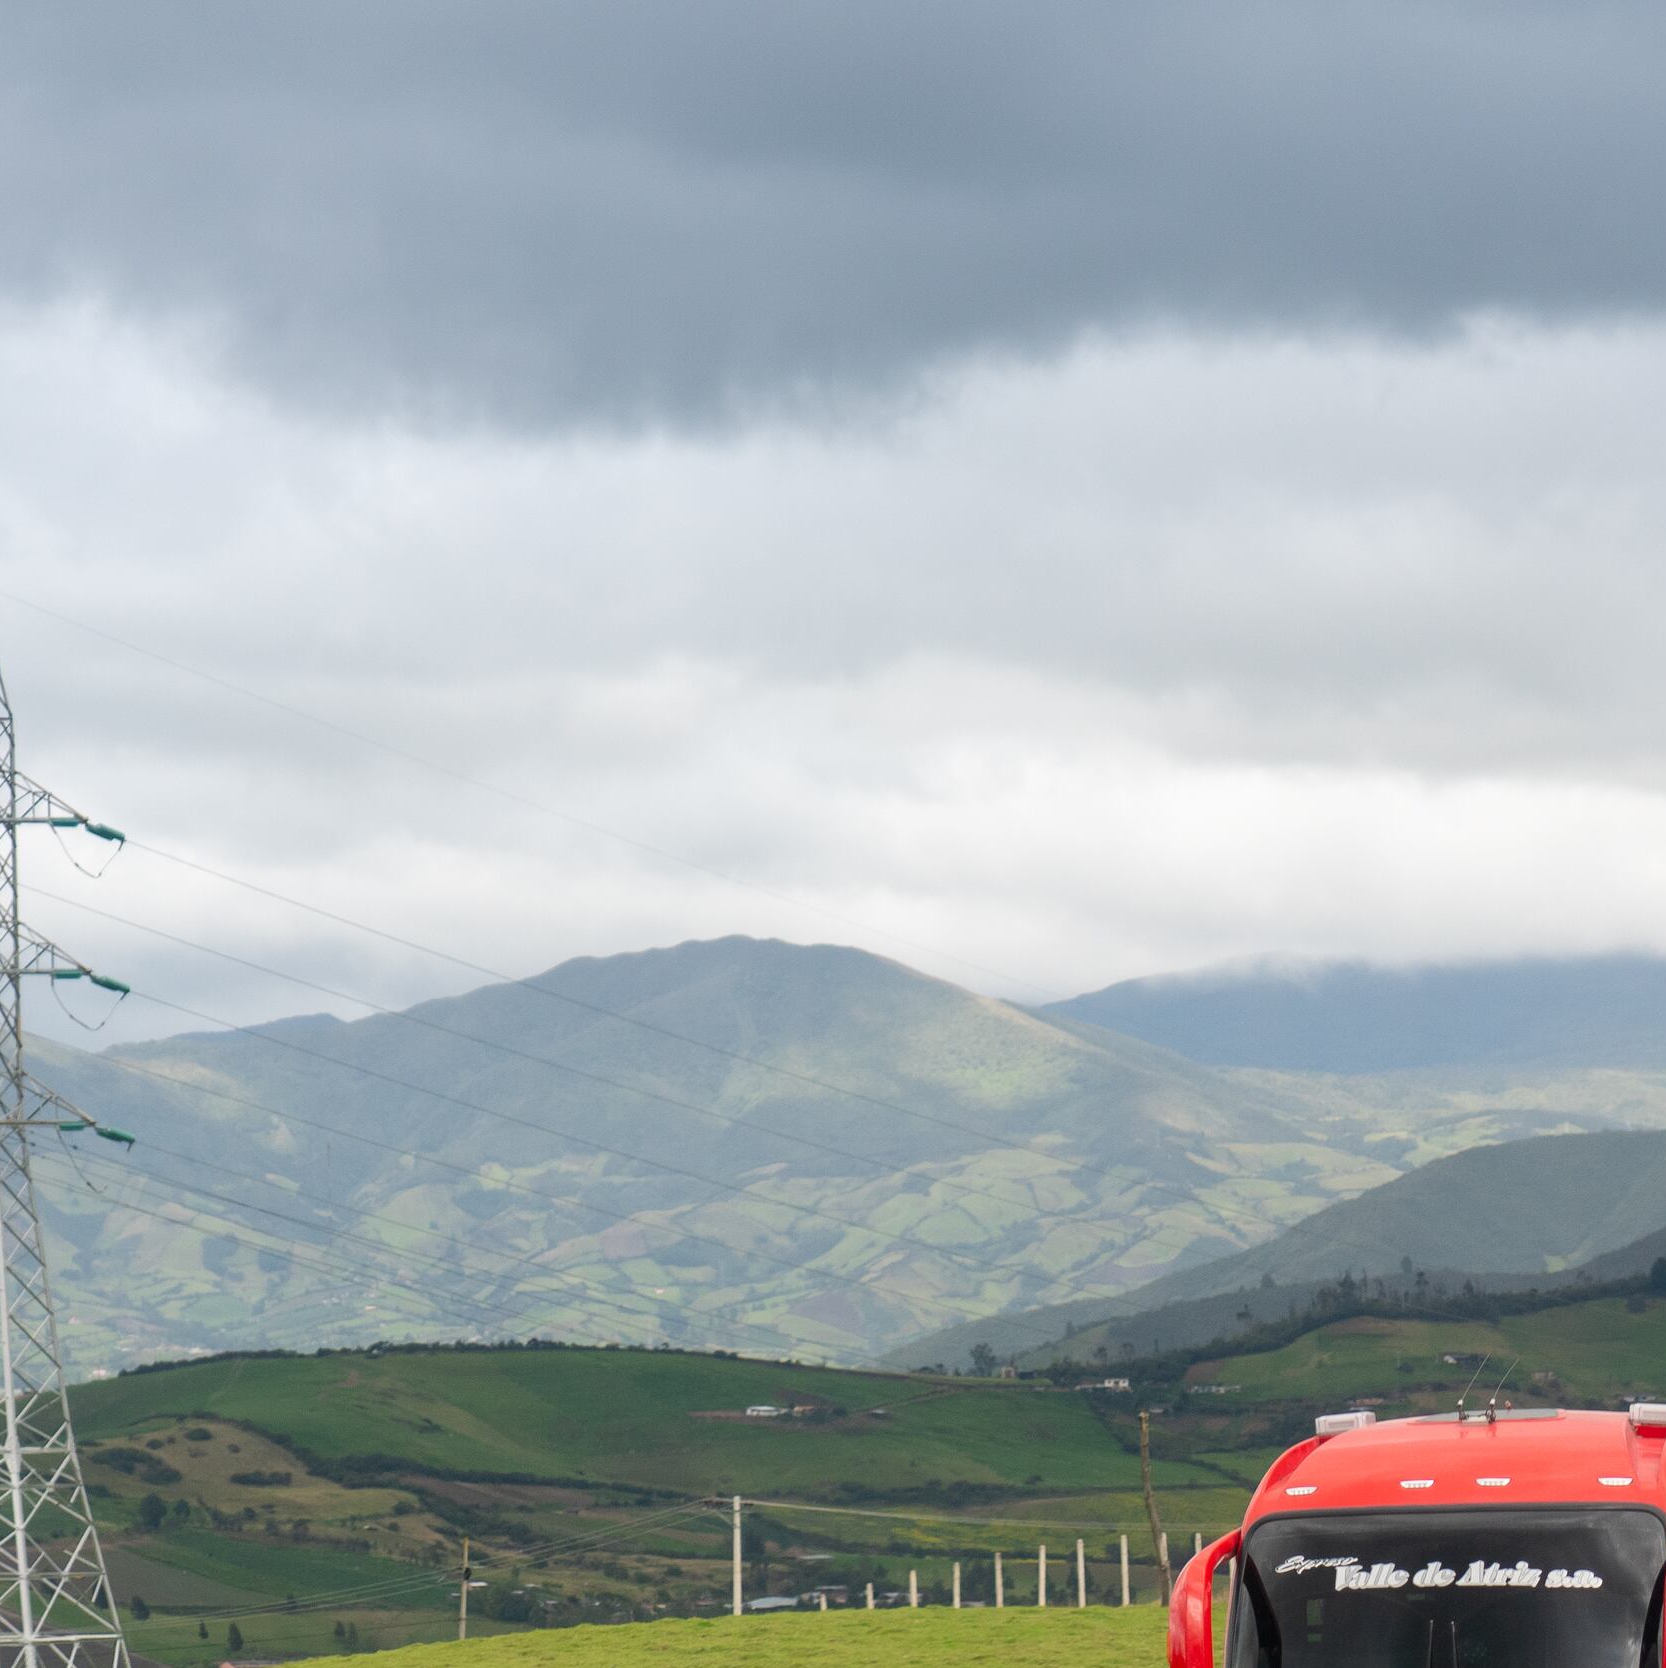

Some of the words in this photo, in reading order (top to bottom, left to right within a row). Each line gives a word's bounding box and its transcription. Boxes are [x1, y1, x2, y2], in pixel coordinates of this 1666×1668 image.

[1335, 1562, 1410, 1591] Valle
[1413, 1561, 1456, 1587] de
[1456, 1560, 1542, 1588] Atriz
